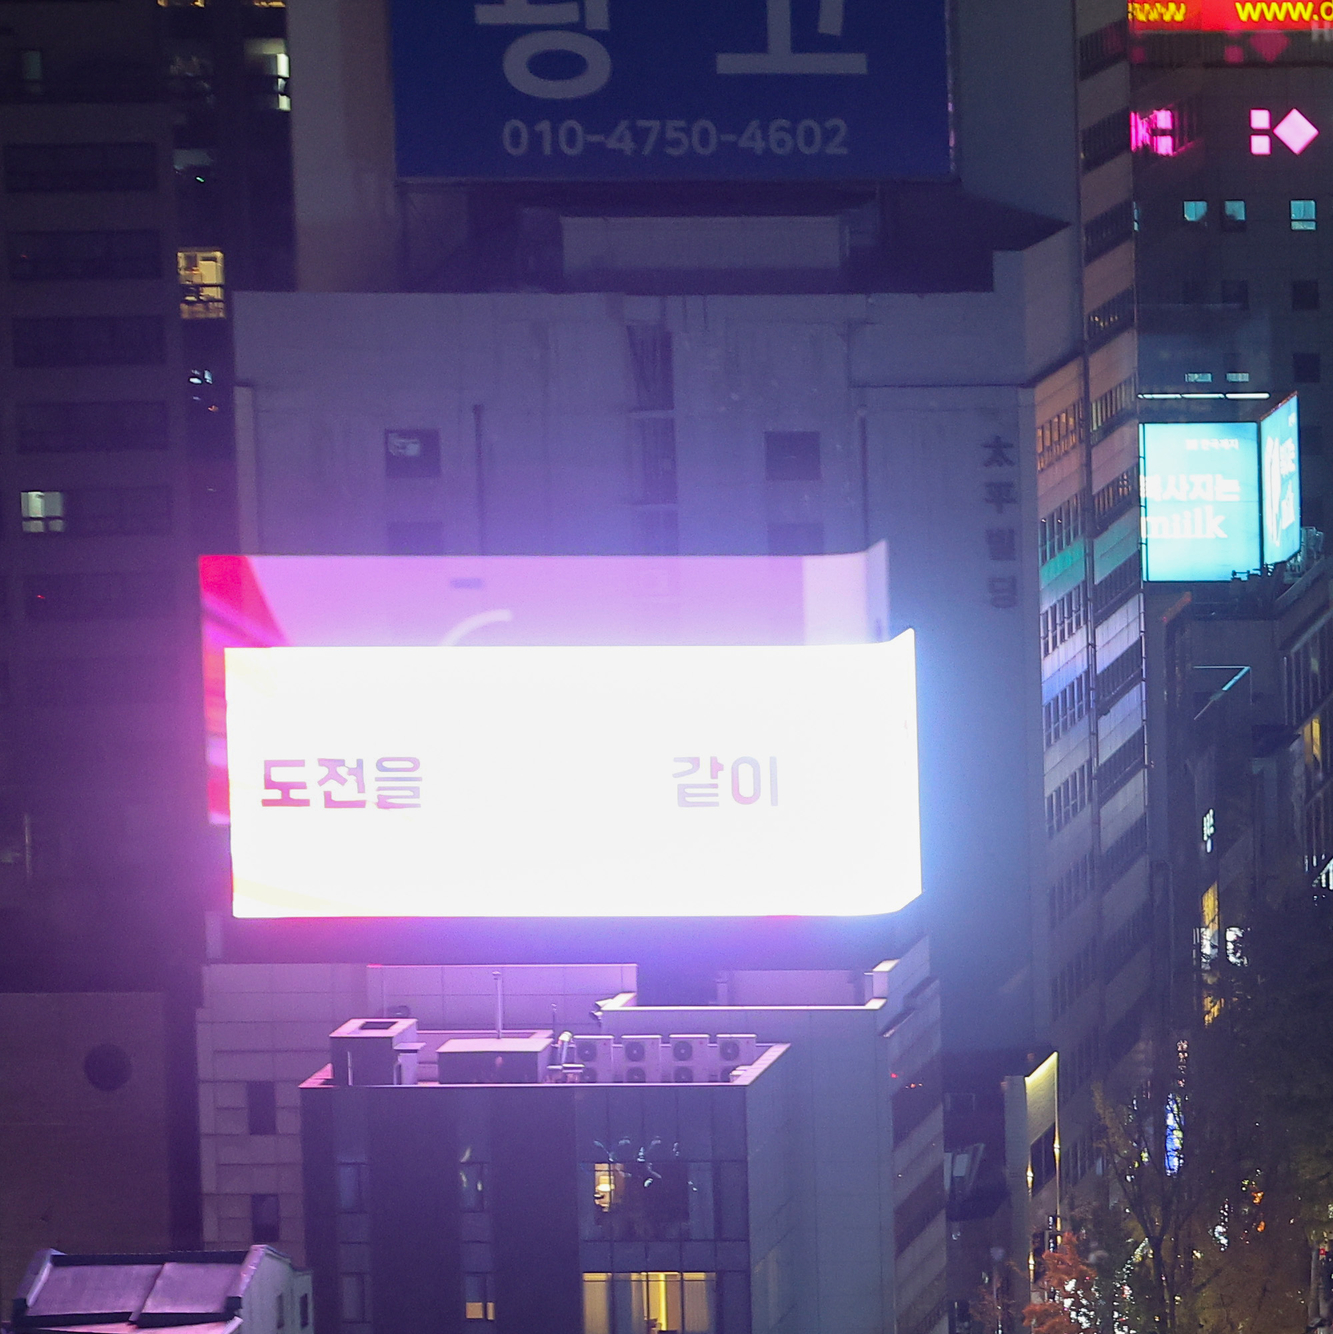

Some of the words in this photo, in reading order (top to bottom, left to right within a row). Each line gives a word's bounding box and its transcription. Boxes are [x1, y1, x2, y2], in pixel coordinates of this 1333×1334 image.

[502, 119, 848, 156] 010-4750-4602
[261, 756, 423, 808] 도전을
[672, 757, 779, 807] 같이
